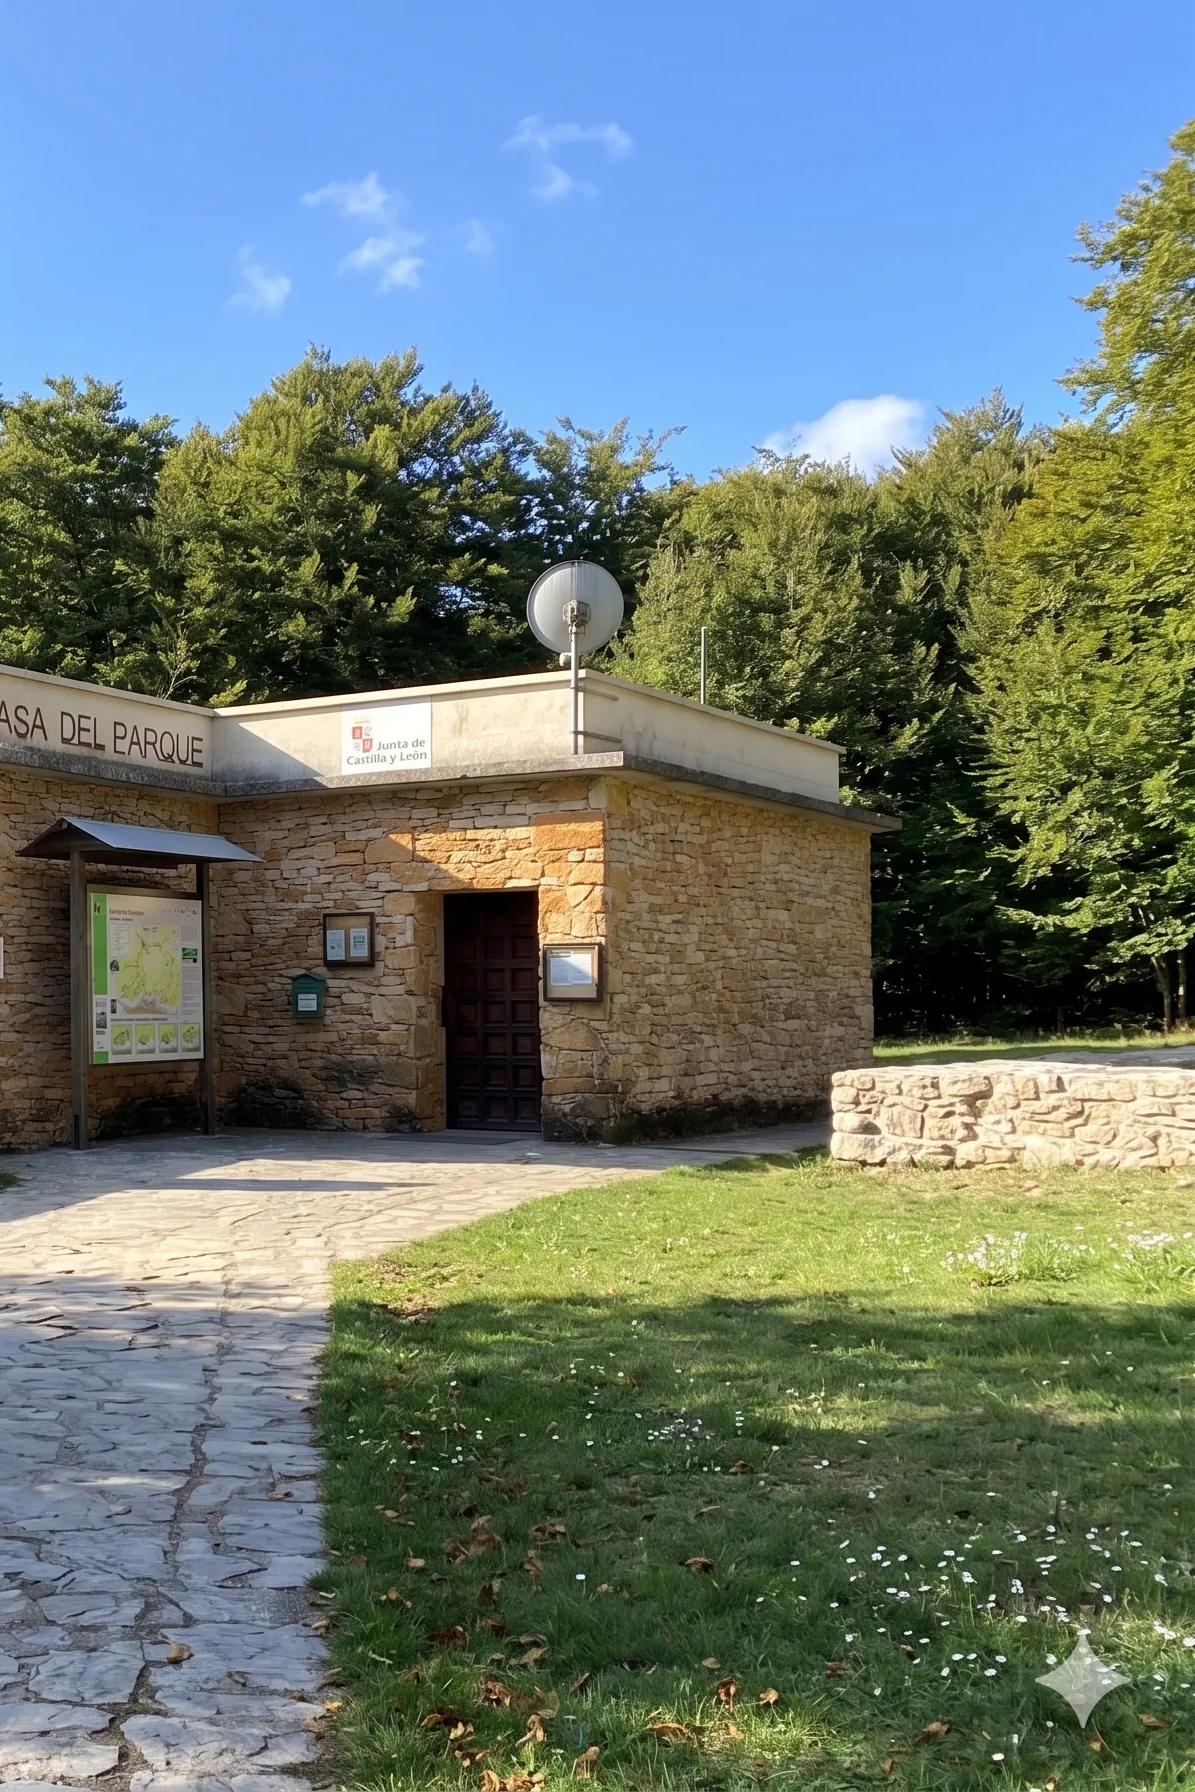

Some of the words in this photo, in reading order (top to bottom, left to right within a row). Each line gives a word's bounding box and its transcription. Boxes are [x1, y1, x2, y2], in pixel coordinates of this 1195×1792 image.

[60, 710, 106, 750] DEL
[113, 720, 204, 768] PARQUE
[376, 740, 408, 751] Junta
[411, 738, 426, 748] de
[346, 753, 387, 765] Castilla
[389, 754, 397, 765] y
[399, 750, 427, 762] León
